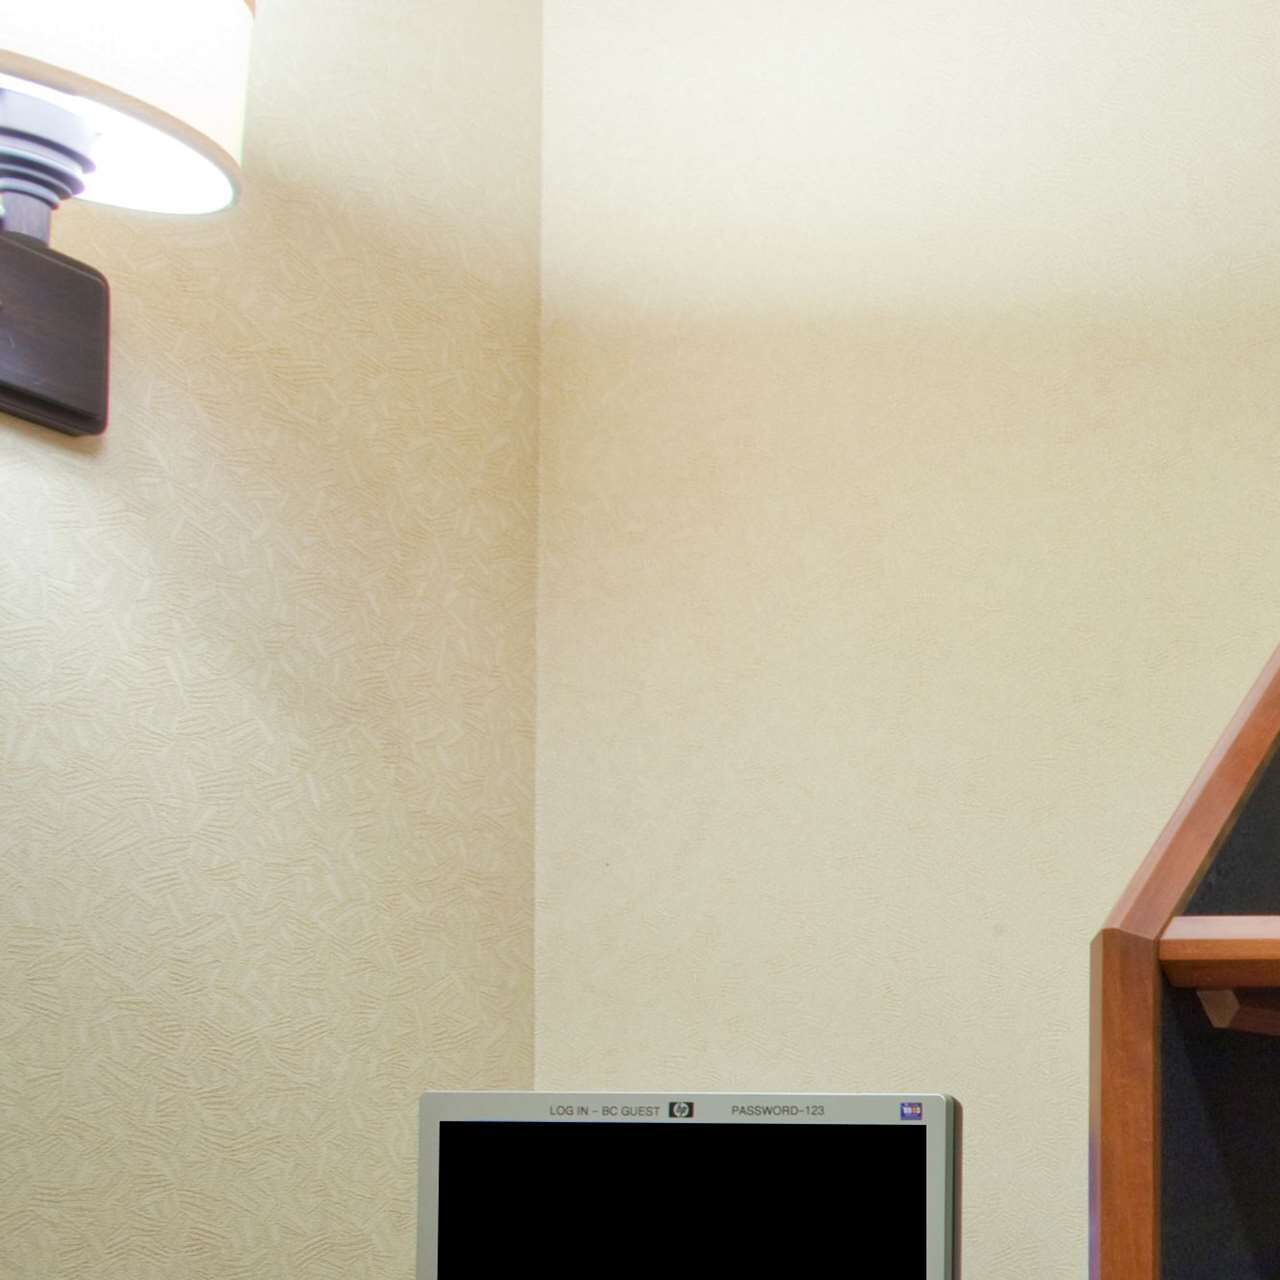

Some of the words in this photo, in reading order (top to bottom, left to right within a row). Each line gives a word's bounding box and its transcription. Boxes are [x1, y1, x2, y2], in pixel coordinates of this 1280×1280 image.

[549, 1105, 574, 1116] LOG
[577, 1105, 589, 1116] IN
[601, 1105, 618, 1117] BC
[620, 1106, 660, 1117] GUEST
[731, 1105, 825, 1116] PASSWORD-123
